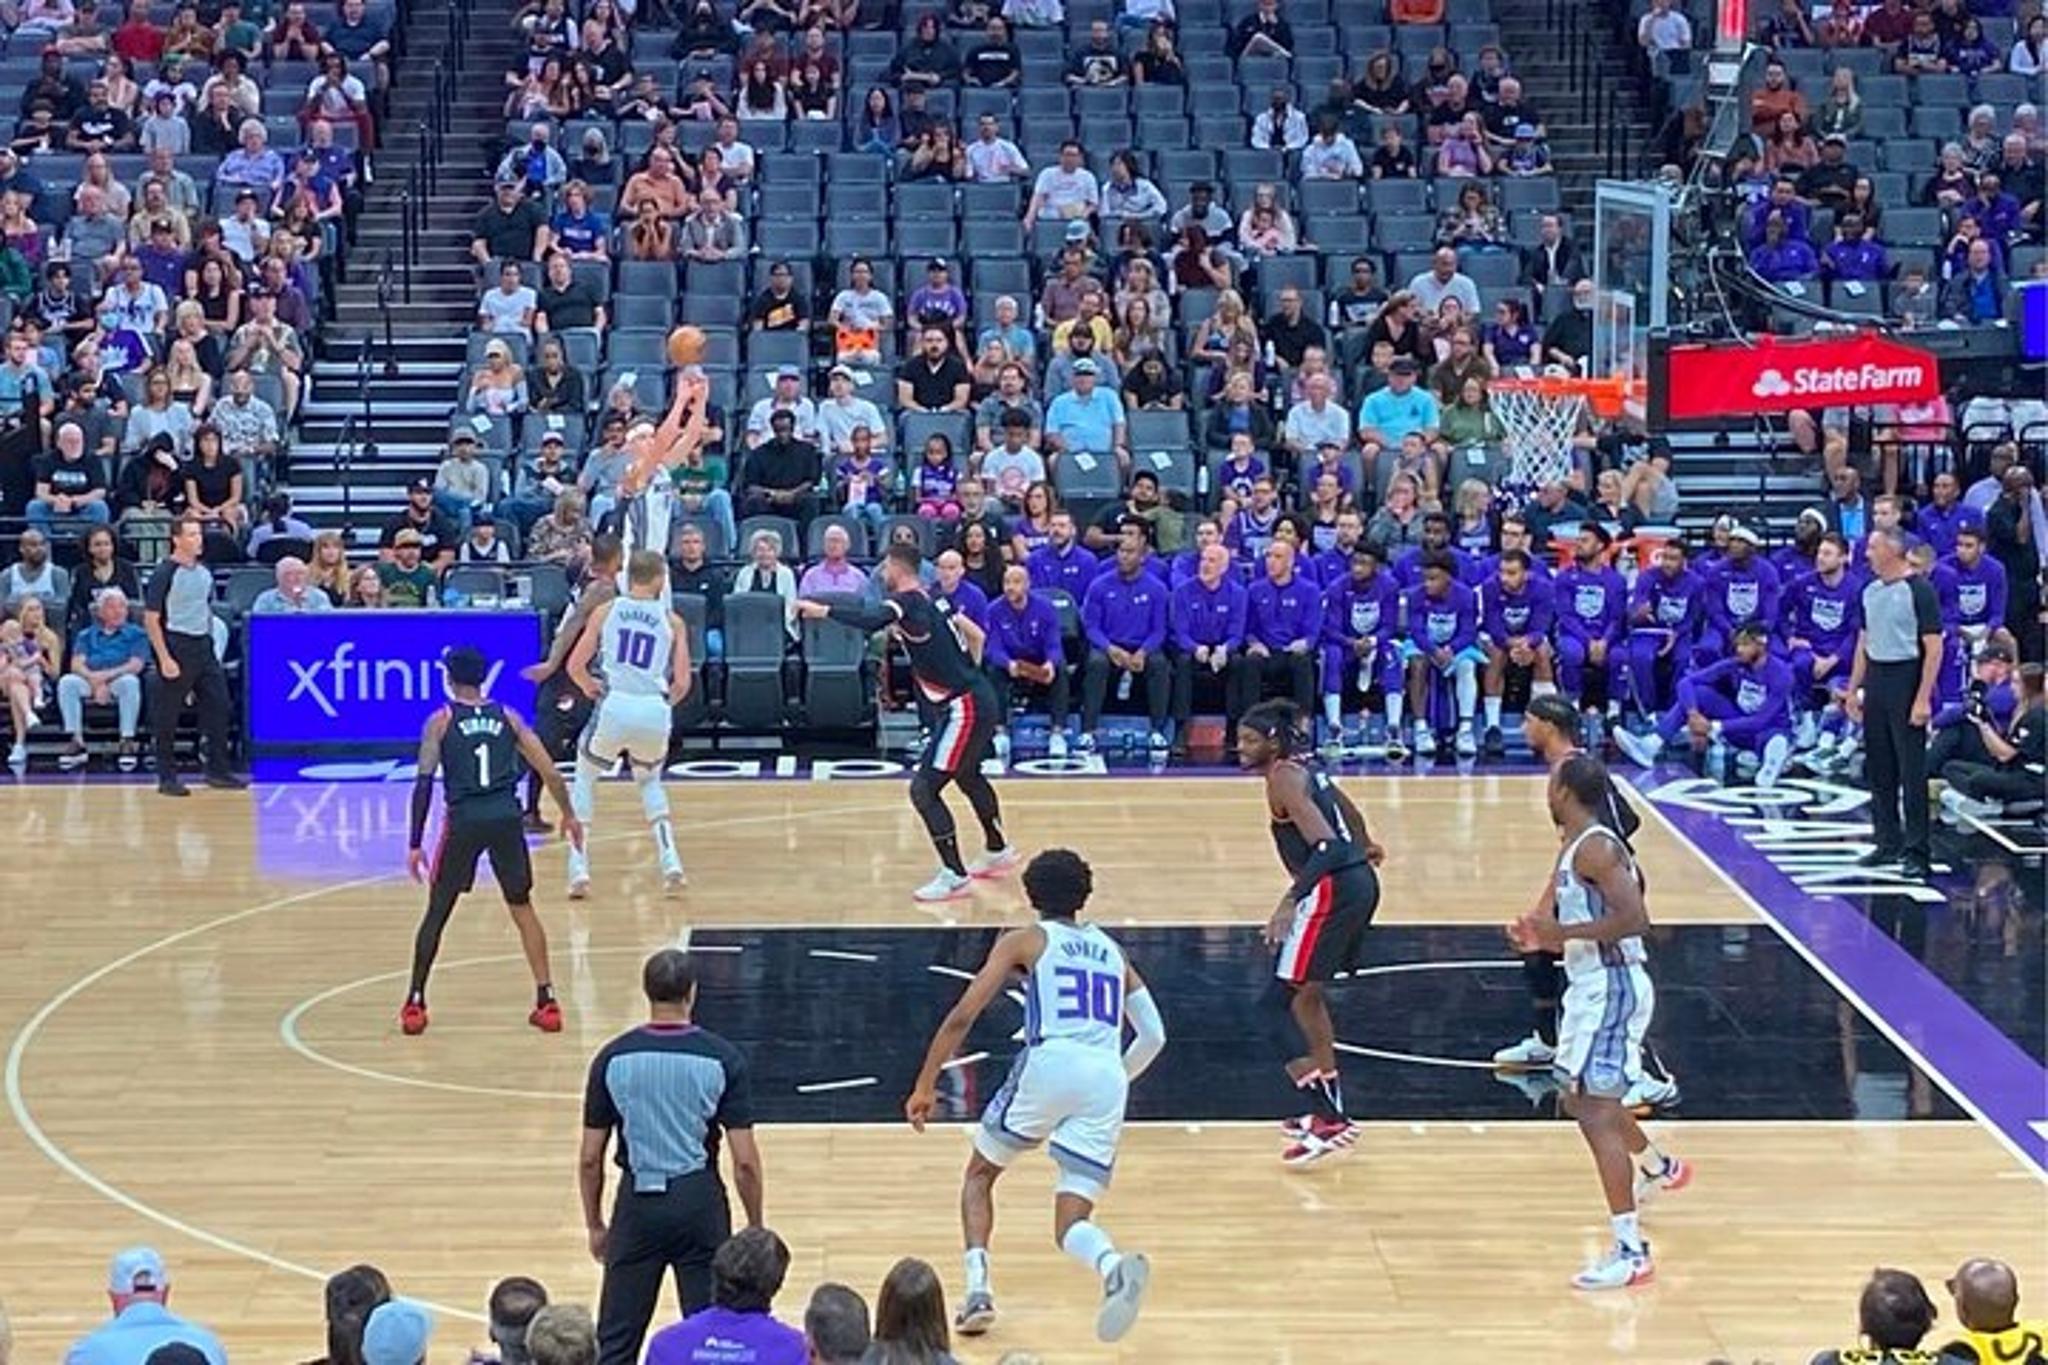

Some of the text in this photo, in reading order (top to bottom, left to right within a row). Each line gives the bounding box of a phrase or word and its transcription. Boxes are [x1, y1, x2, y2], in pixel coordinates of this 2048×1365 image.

[617, 628, 657, 670] 10
[474, 743, 490, 787] 1
[1055, 966, 1120, 1028] 30
